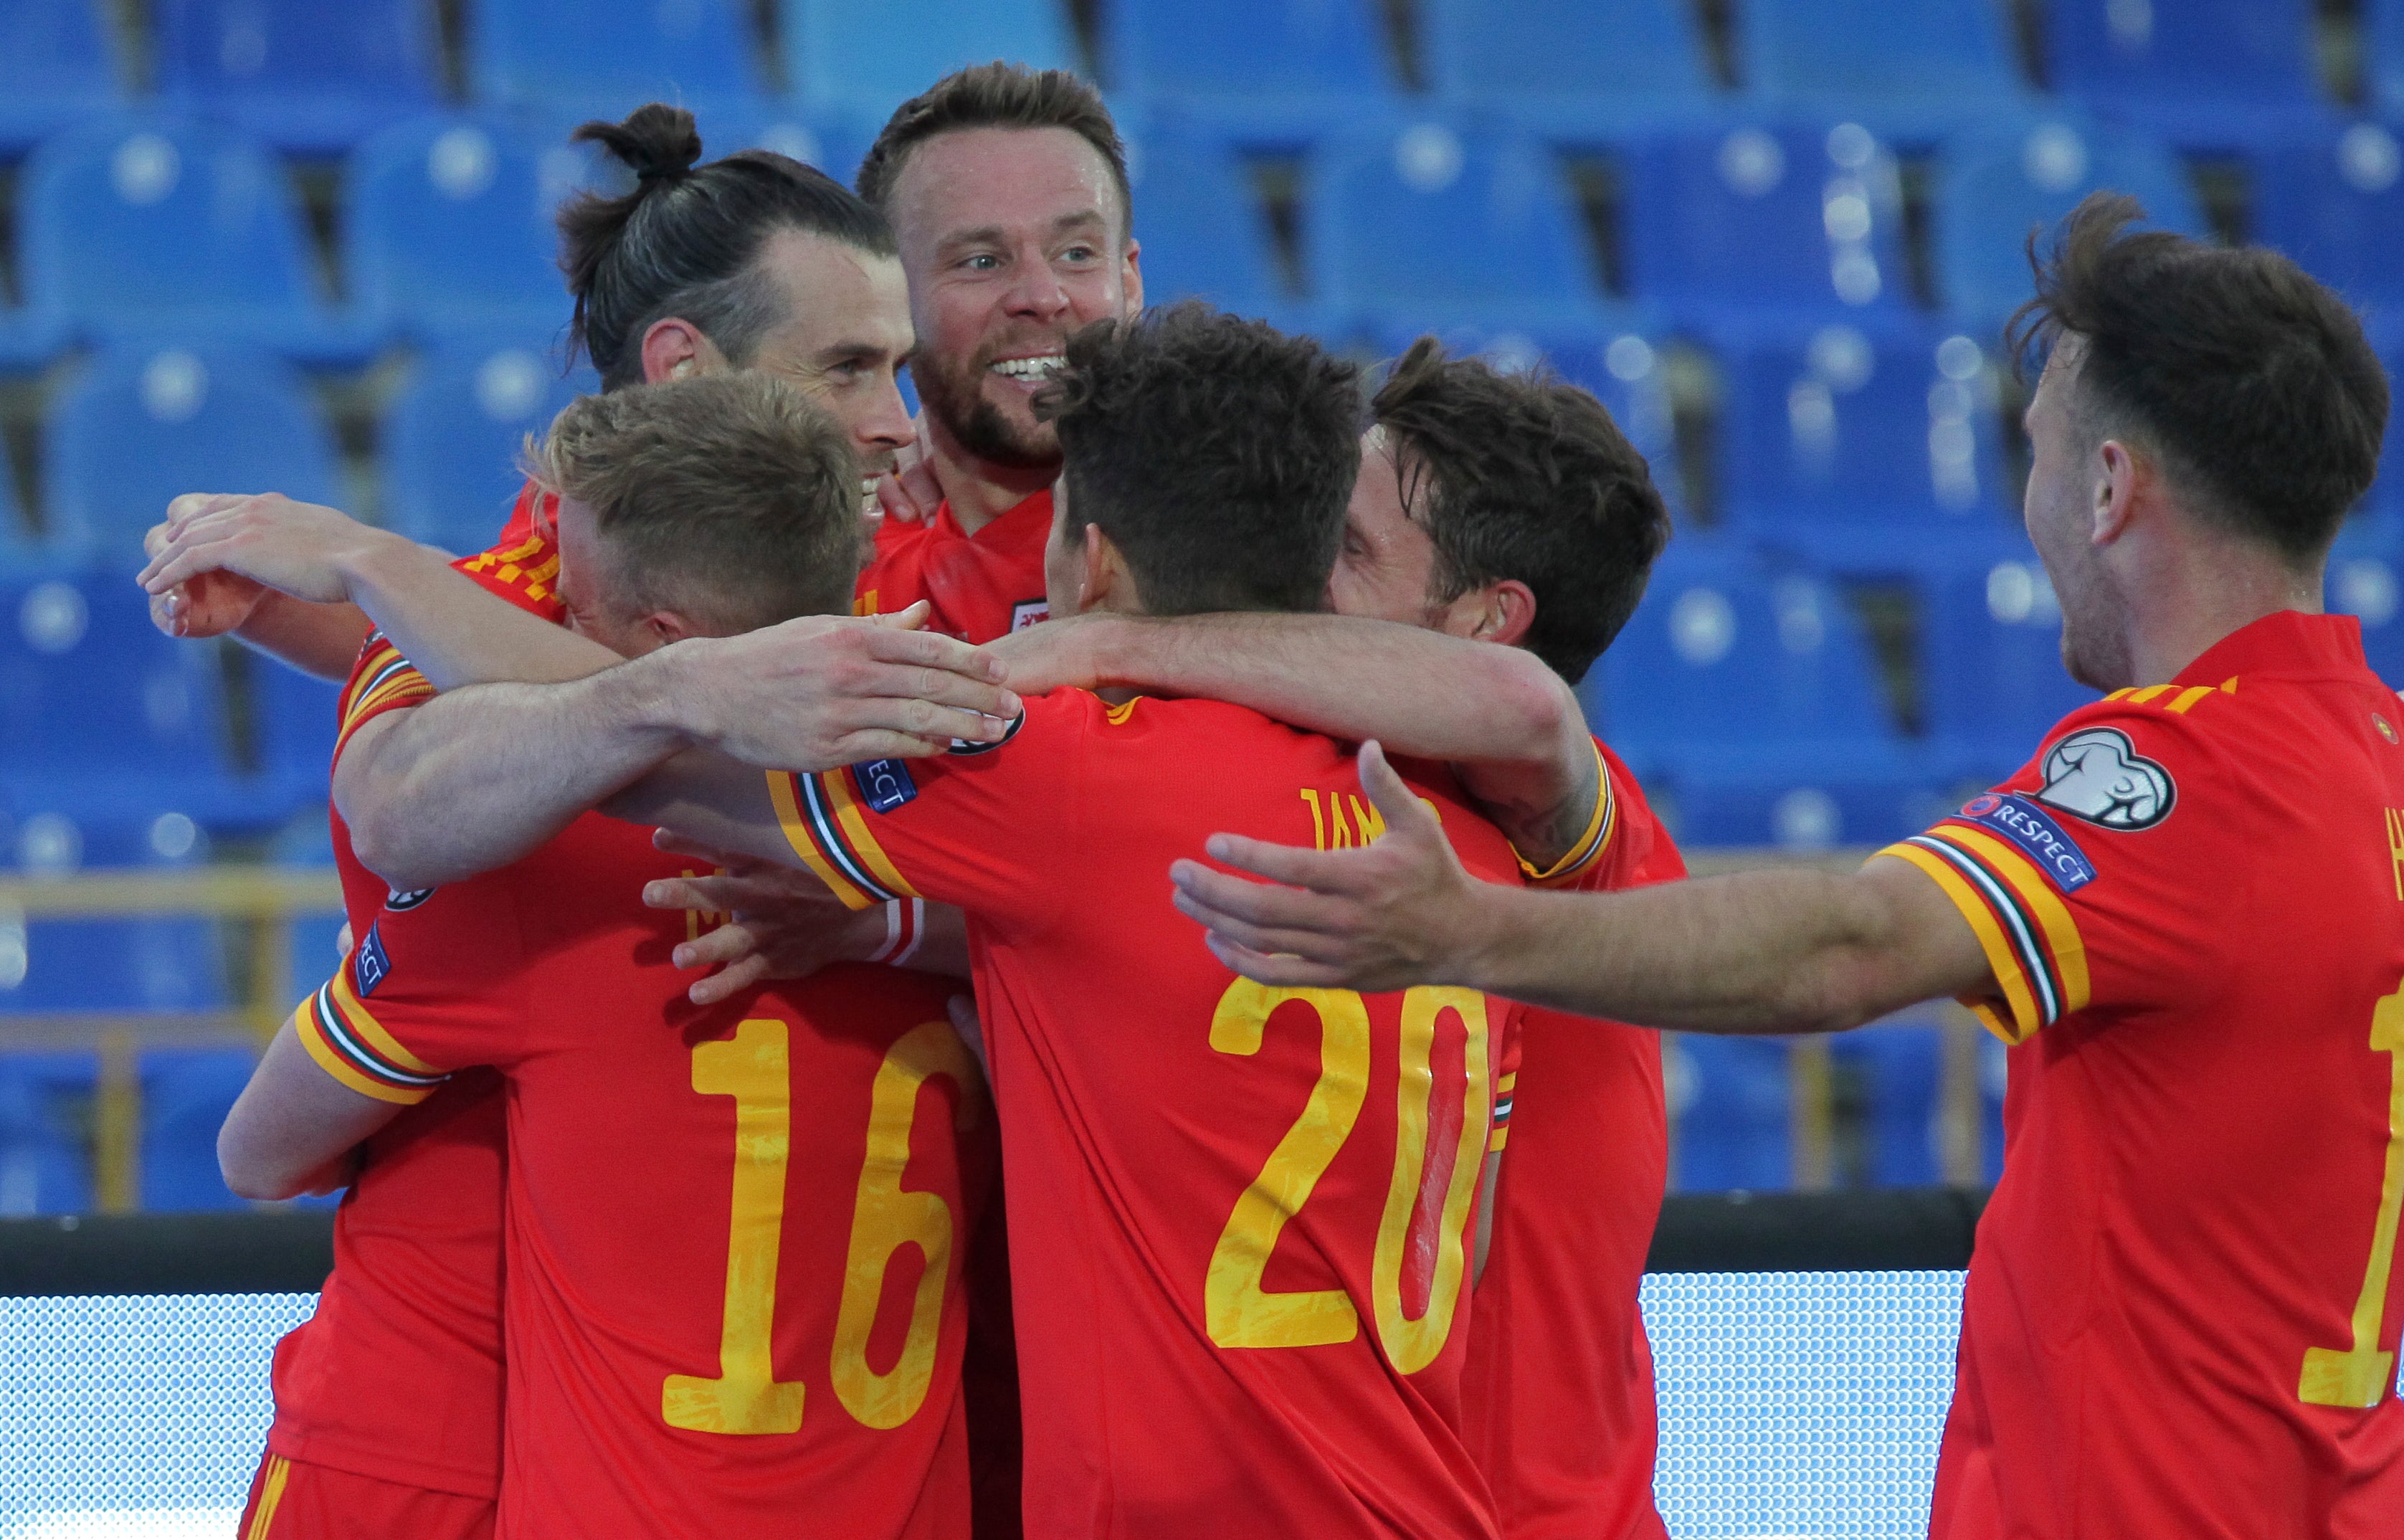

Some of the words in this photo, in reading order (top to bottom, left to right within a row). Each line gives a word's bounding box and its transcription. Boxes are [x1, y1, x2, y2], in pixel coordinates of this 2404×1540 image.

[868, 759, 904, 804] ECT
[1993, 804, 2089, 883] RESPECT
[662, 1019, 979, 1435] 16
[1205, 954, 1490, 1375] 20
